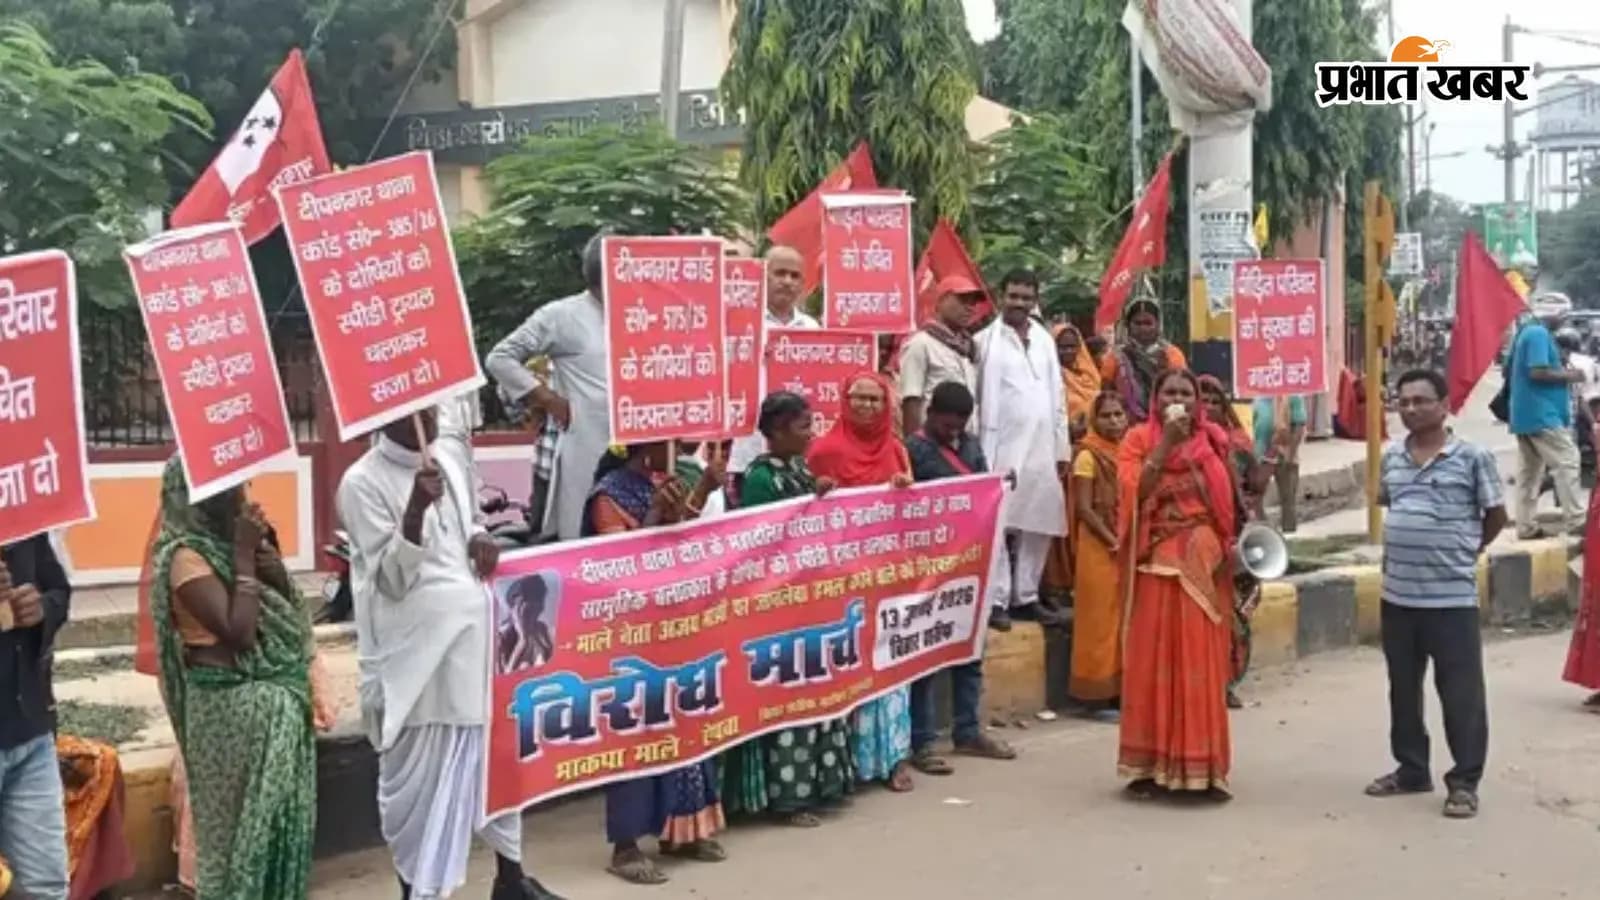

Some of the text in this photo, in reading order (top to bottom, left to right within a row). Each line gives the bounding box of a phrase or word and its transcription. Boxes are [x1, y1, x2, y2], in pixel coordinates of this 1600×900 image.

[298, 186, 374, 221] दीपनगर
[376, 174, 415, 200] थाना
[300, 230, 343, 262] कांड
[840, 240, 860, 271] को
[320, 243, 432, 297] के दोषियों को
[613, 246, 715, 283] दीपनगर कांड
[0, 278, 58, 340] रिवार
[336, 295, 388, 335] स्पीडी
[1239, 309, 1258, 340] को
[166, 323, 185, 351] के
[363, 327, 428, 362] चलाकर
[775, 335, 870, 365] दीपनगर कांड
[620, 348, 638, 380] के
[642, 343, 694, 379] दोषियों
[695, 344, 716, 376] को
[0, 366, 36, 423] चित
[369, 372, 410, 402] सजा
[817, 381, 841, 403] 575
[30, 437, 60, 497] दो
[880, 607, 899, 630] 13
[508, 649, 728, 763] विरोध
[742, 596, 866, 689] मार्च
[634, 734, 681, 764] माले
